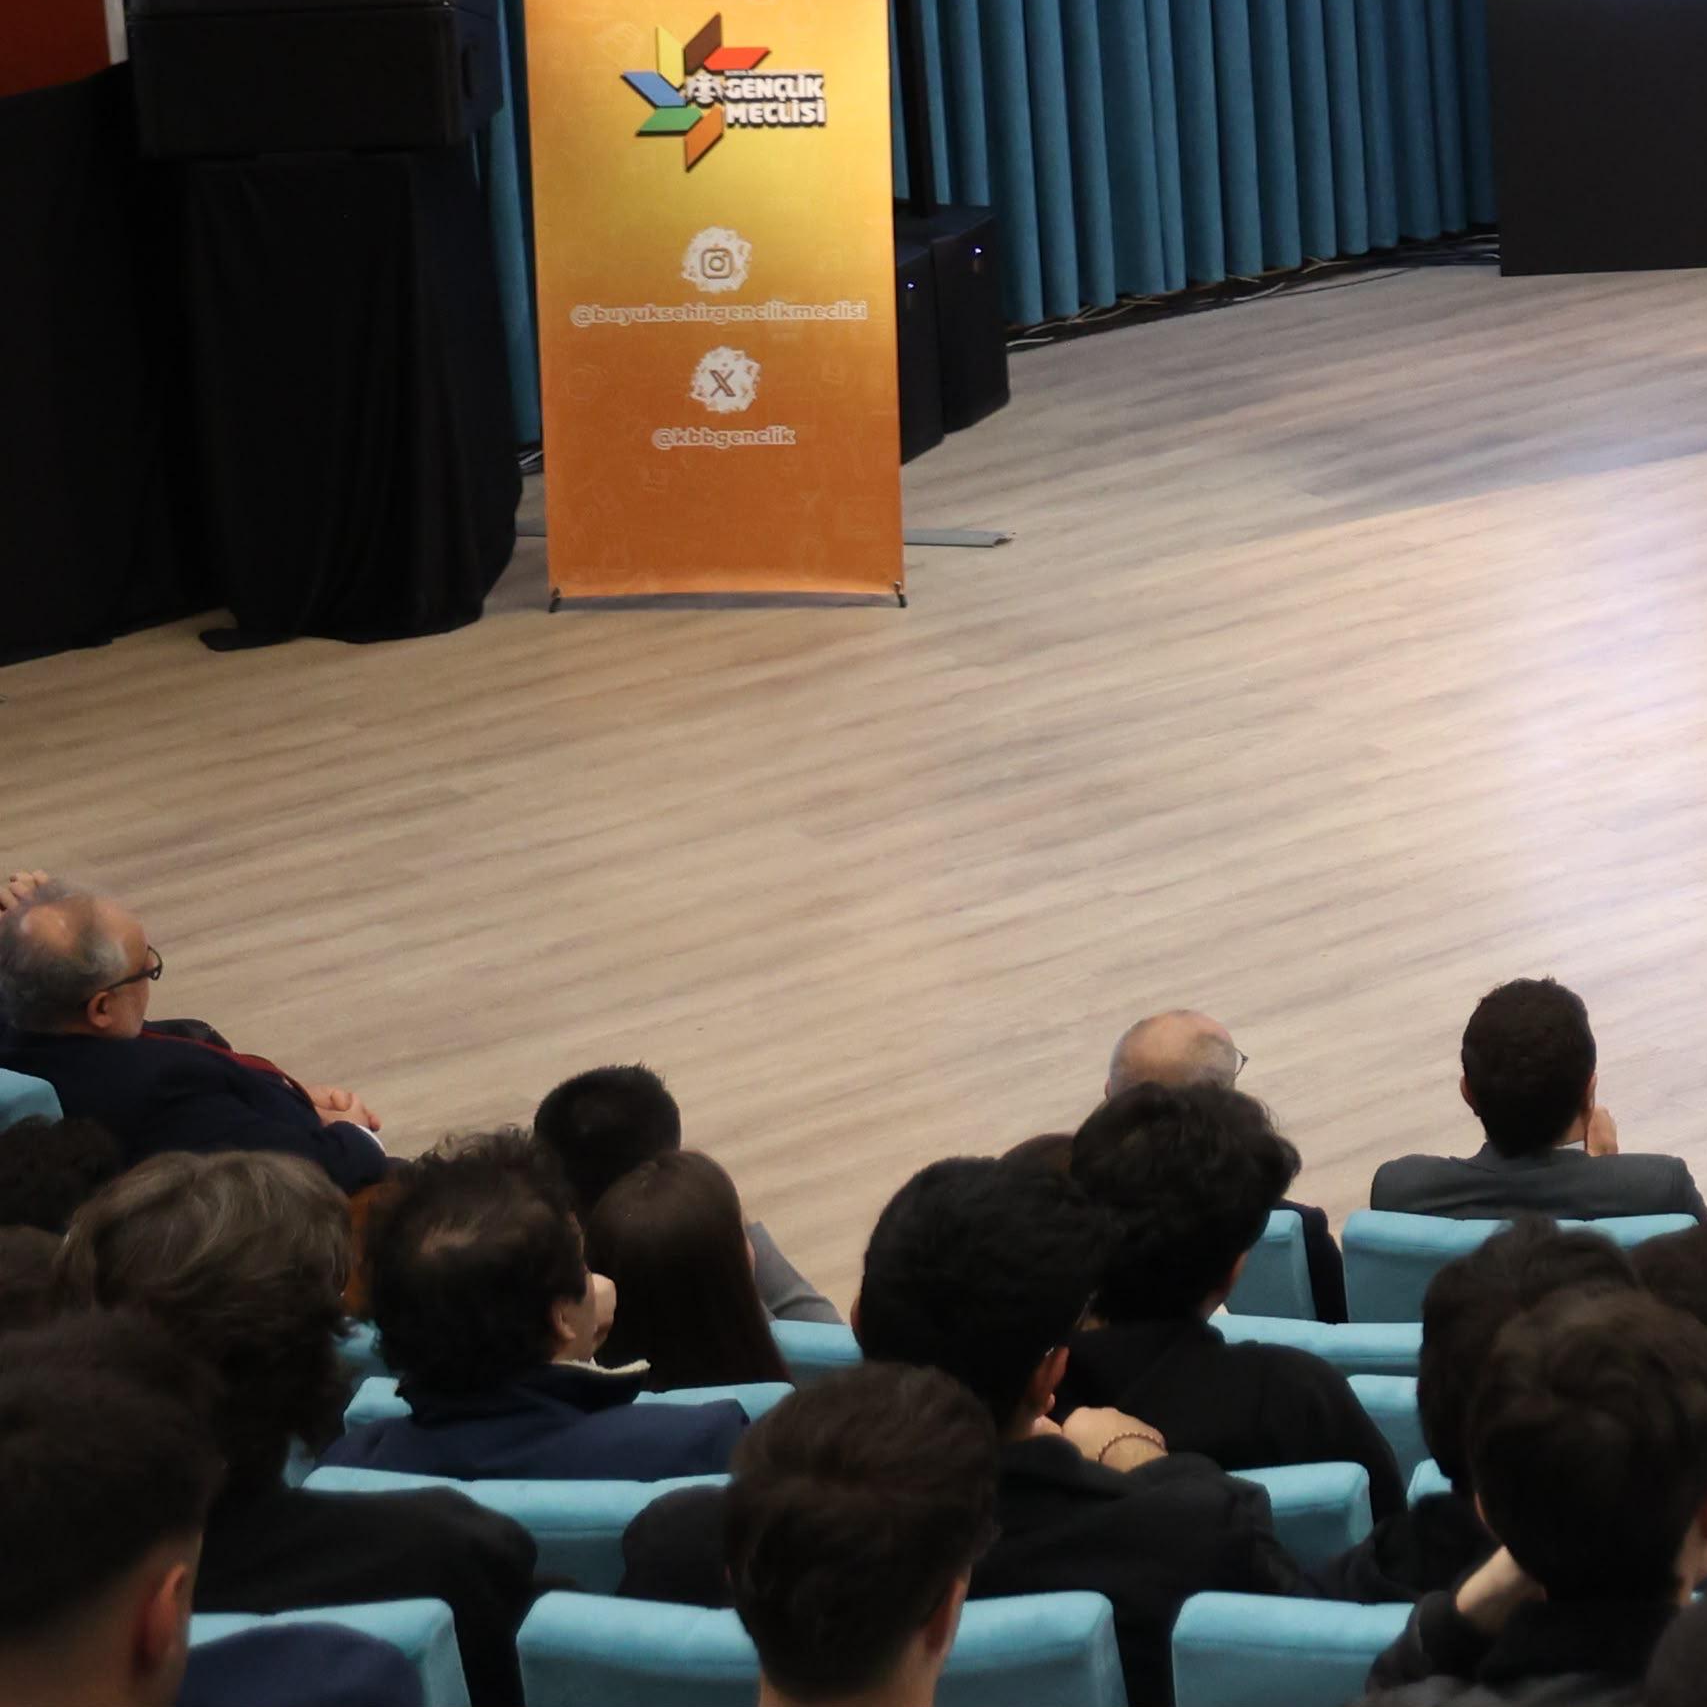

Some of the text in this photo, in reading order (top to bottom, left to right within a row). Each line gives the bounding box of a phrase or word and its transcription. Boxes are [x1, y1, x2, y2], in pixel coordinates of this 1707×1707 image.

[724, 74, 824, 102] GENÇLİK
[725, 99, 826, 125] MECLİSİ
[570, 301, 868, 328] @buyuksehirgenclikmeclisi
[652, 425, 796, 450] @kbbgenclik
